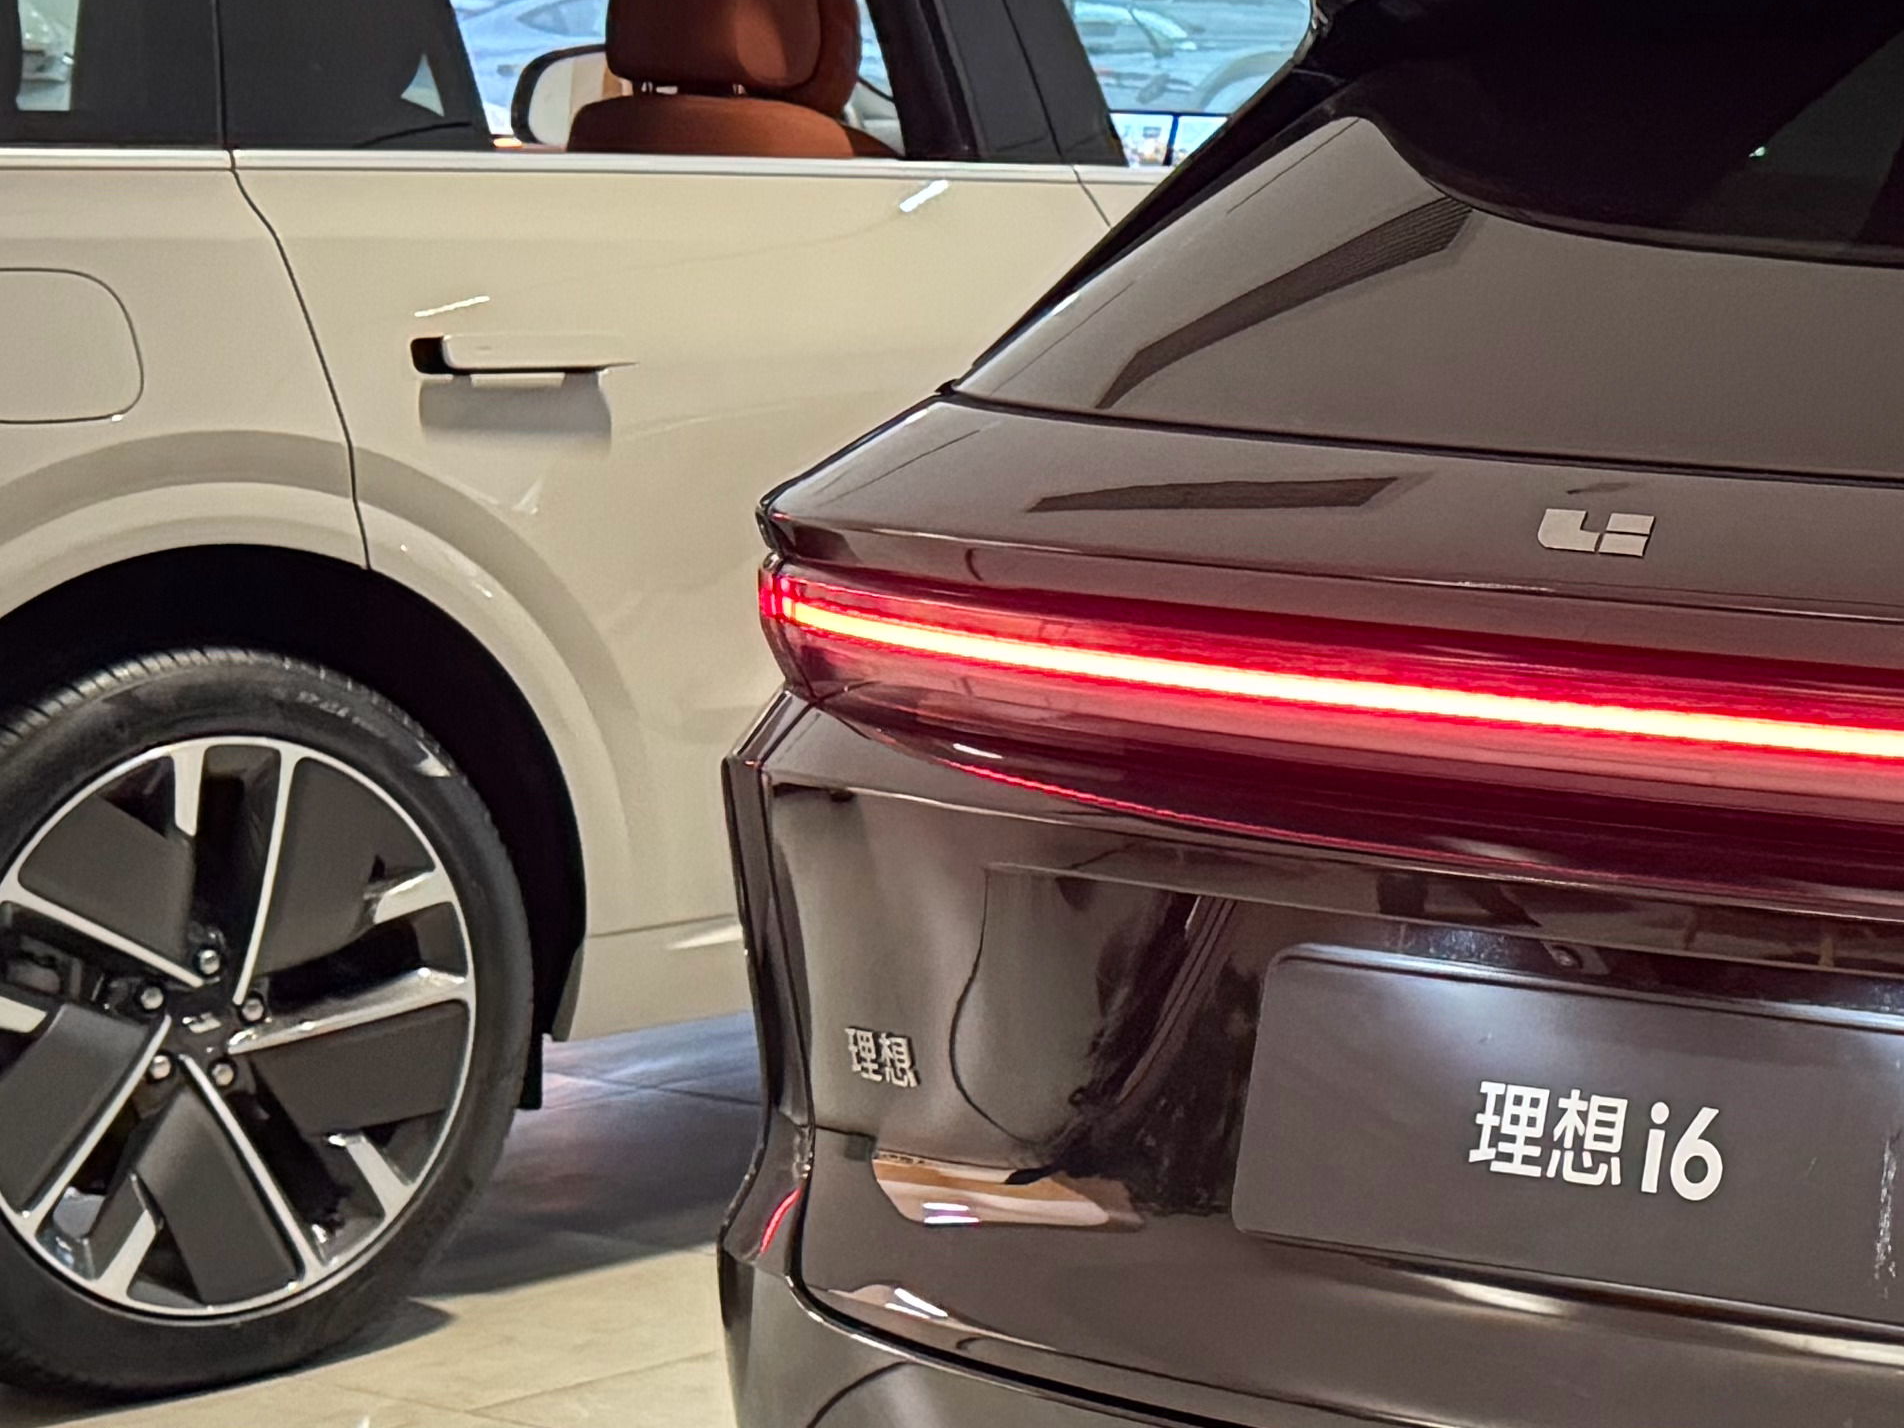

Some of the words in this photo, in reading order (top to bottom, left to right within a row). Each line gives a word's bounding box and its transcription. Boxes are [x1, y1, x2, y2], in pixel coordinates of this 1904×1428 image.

[844, 1027, 920, 1088] 理想
[1468, 1079, 1629, 1187] 理想
[1640, 1100, 1725, 1202] i6
